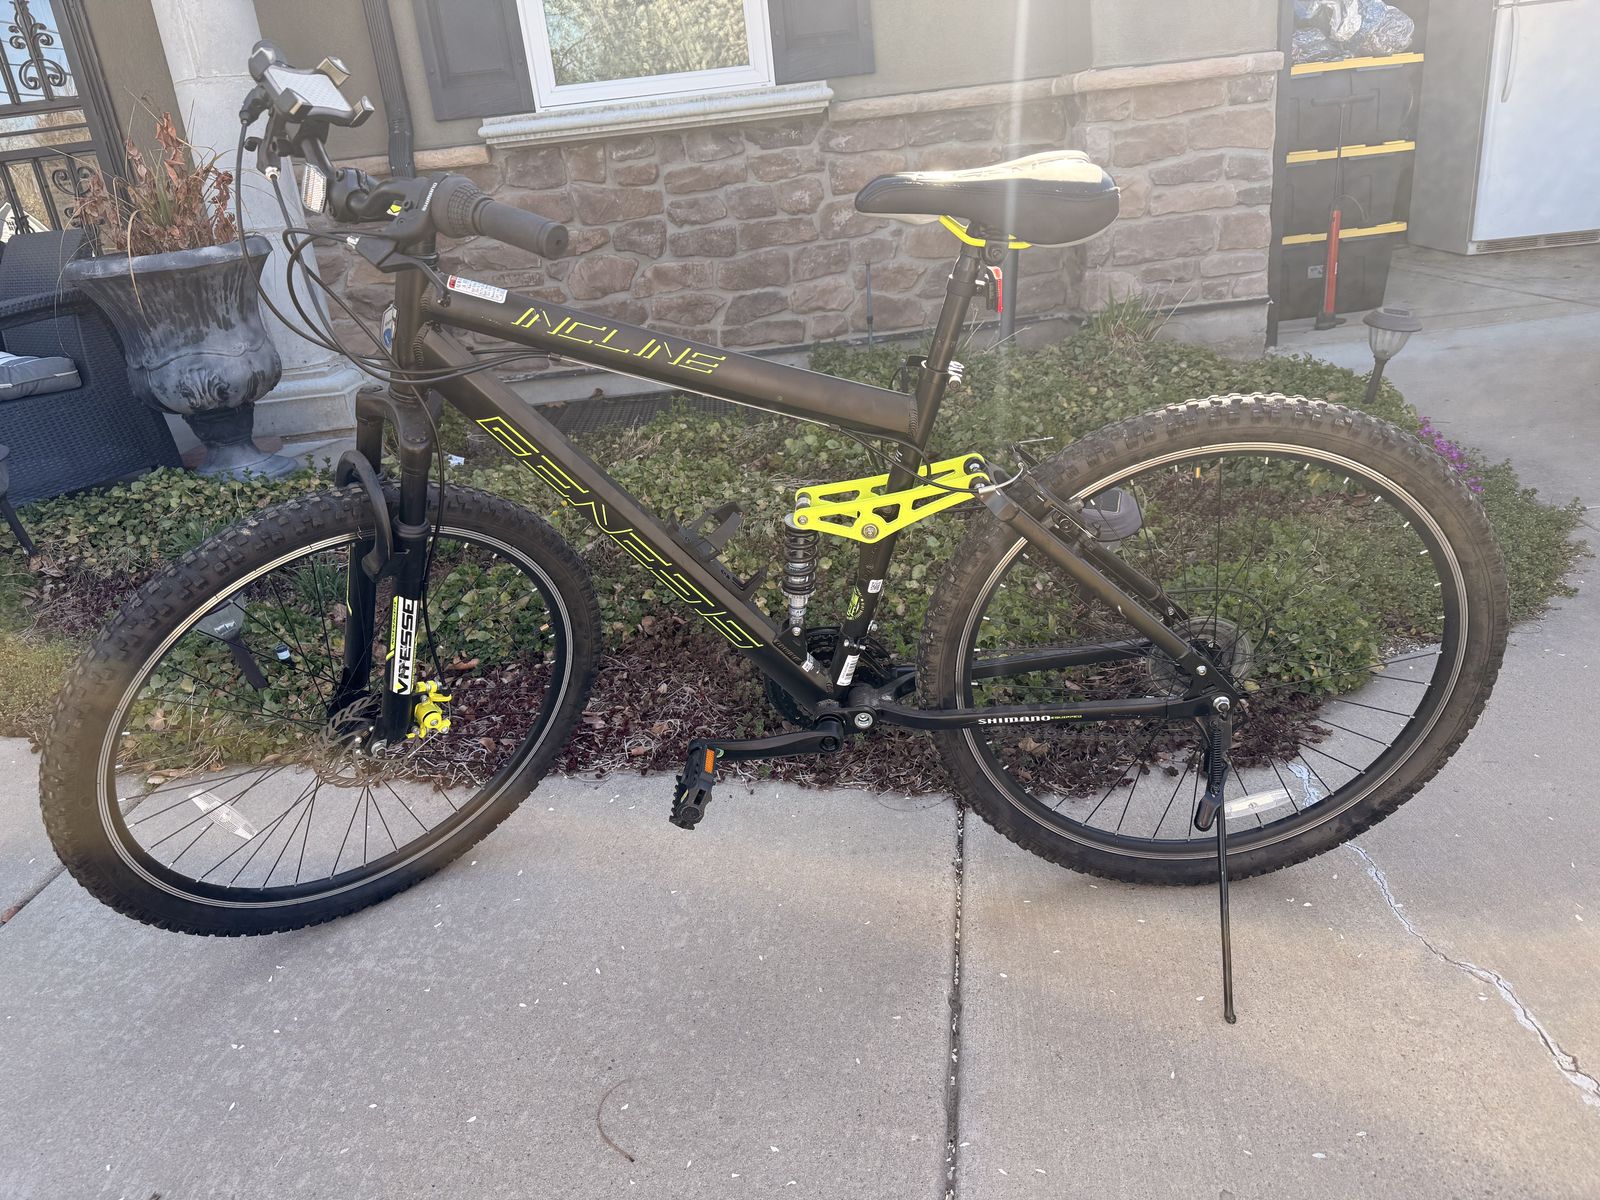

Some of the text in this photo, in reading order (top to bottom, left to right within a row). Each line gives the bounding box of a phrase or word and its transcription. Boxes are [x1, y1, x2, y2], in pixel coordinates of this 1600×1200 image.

[511, 306, 727, 375] INCLINE
[476, 416, 764, 649] GENESIS
[397, 598, 415, 694] VITESSE
[978, 714, 1051, 725] SHIMANO
